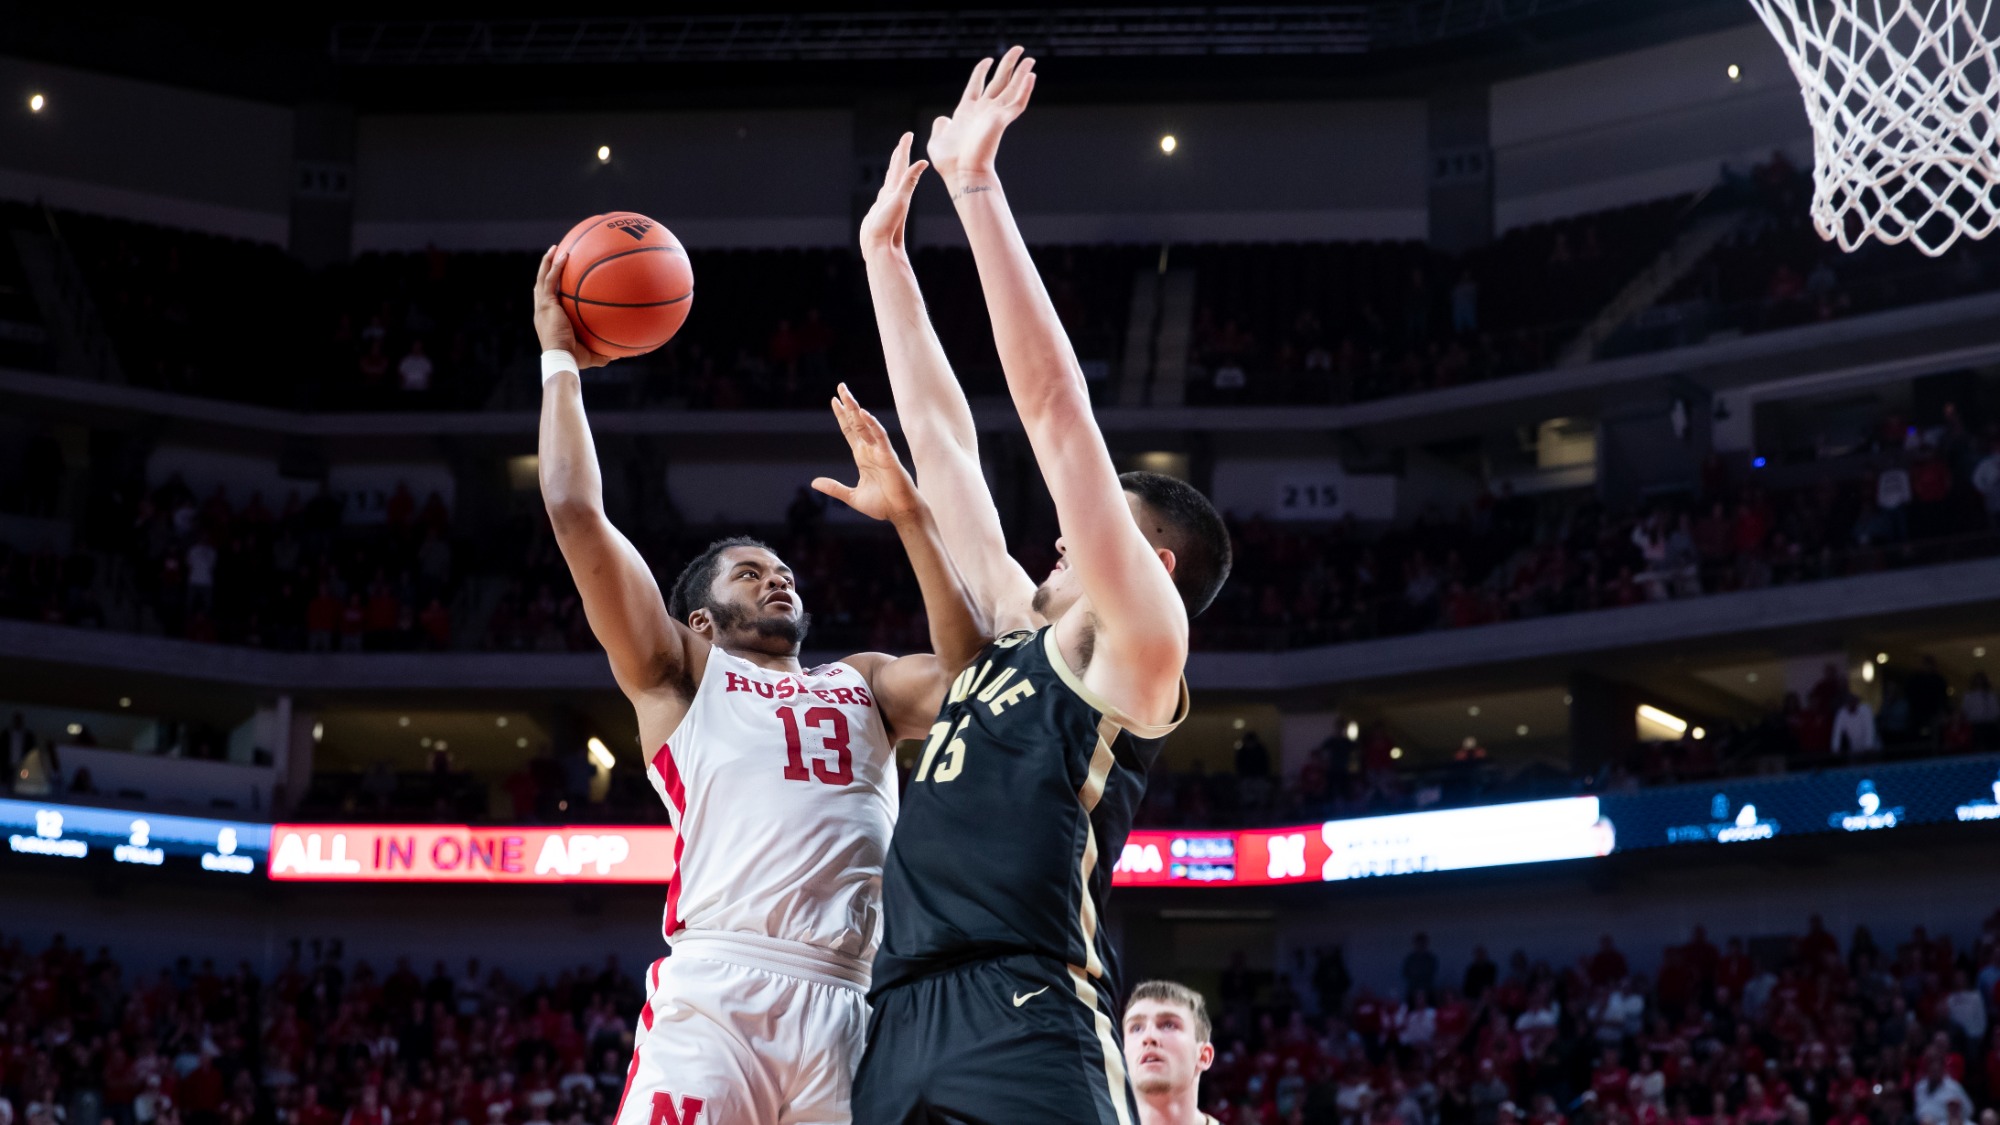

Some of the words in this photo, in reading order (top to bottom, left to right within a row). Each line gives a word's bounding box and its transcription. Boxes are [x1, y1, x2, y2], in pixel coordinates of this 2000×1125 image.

[607, 218, 653, 229] adidas
[1283, 484, 1338, 507] 215
[775, 706, 854, 786] 13
[915, 715, 971, 783] 15
[129, 819, 150, 847] 2
[271, 833, 361, 873] ALL
[373, 836, 414, 871] IN
[432, 836, 525, 872] ONE
[535, 834, 630, 874] APP
[1267, 834, 1306, 878] N
[648, 1090, 706, 1125] N
